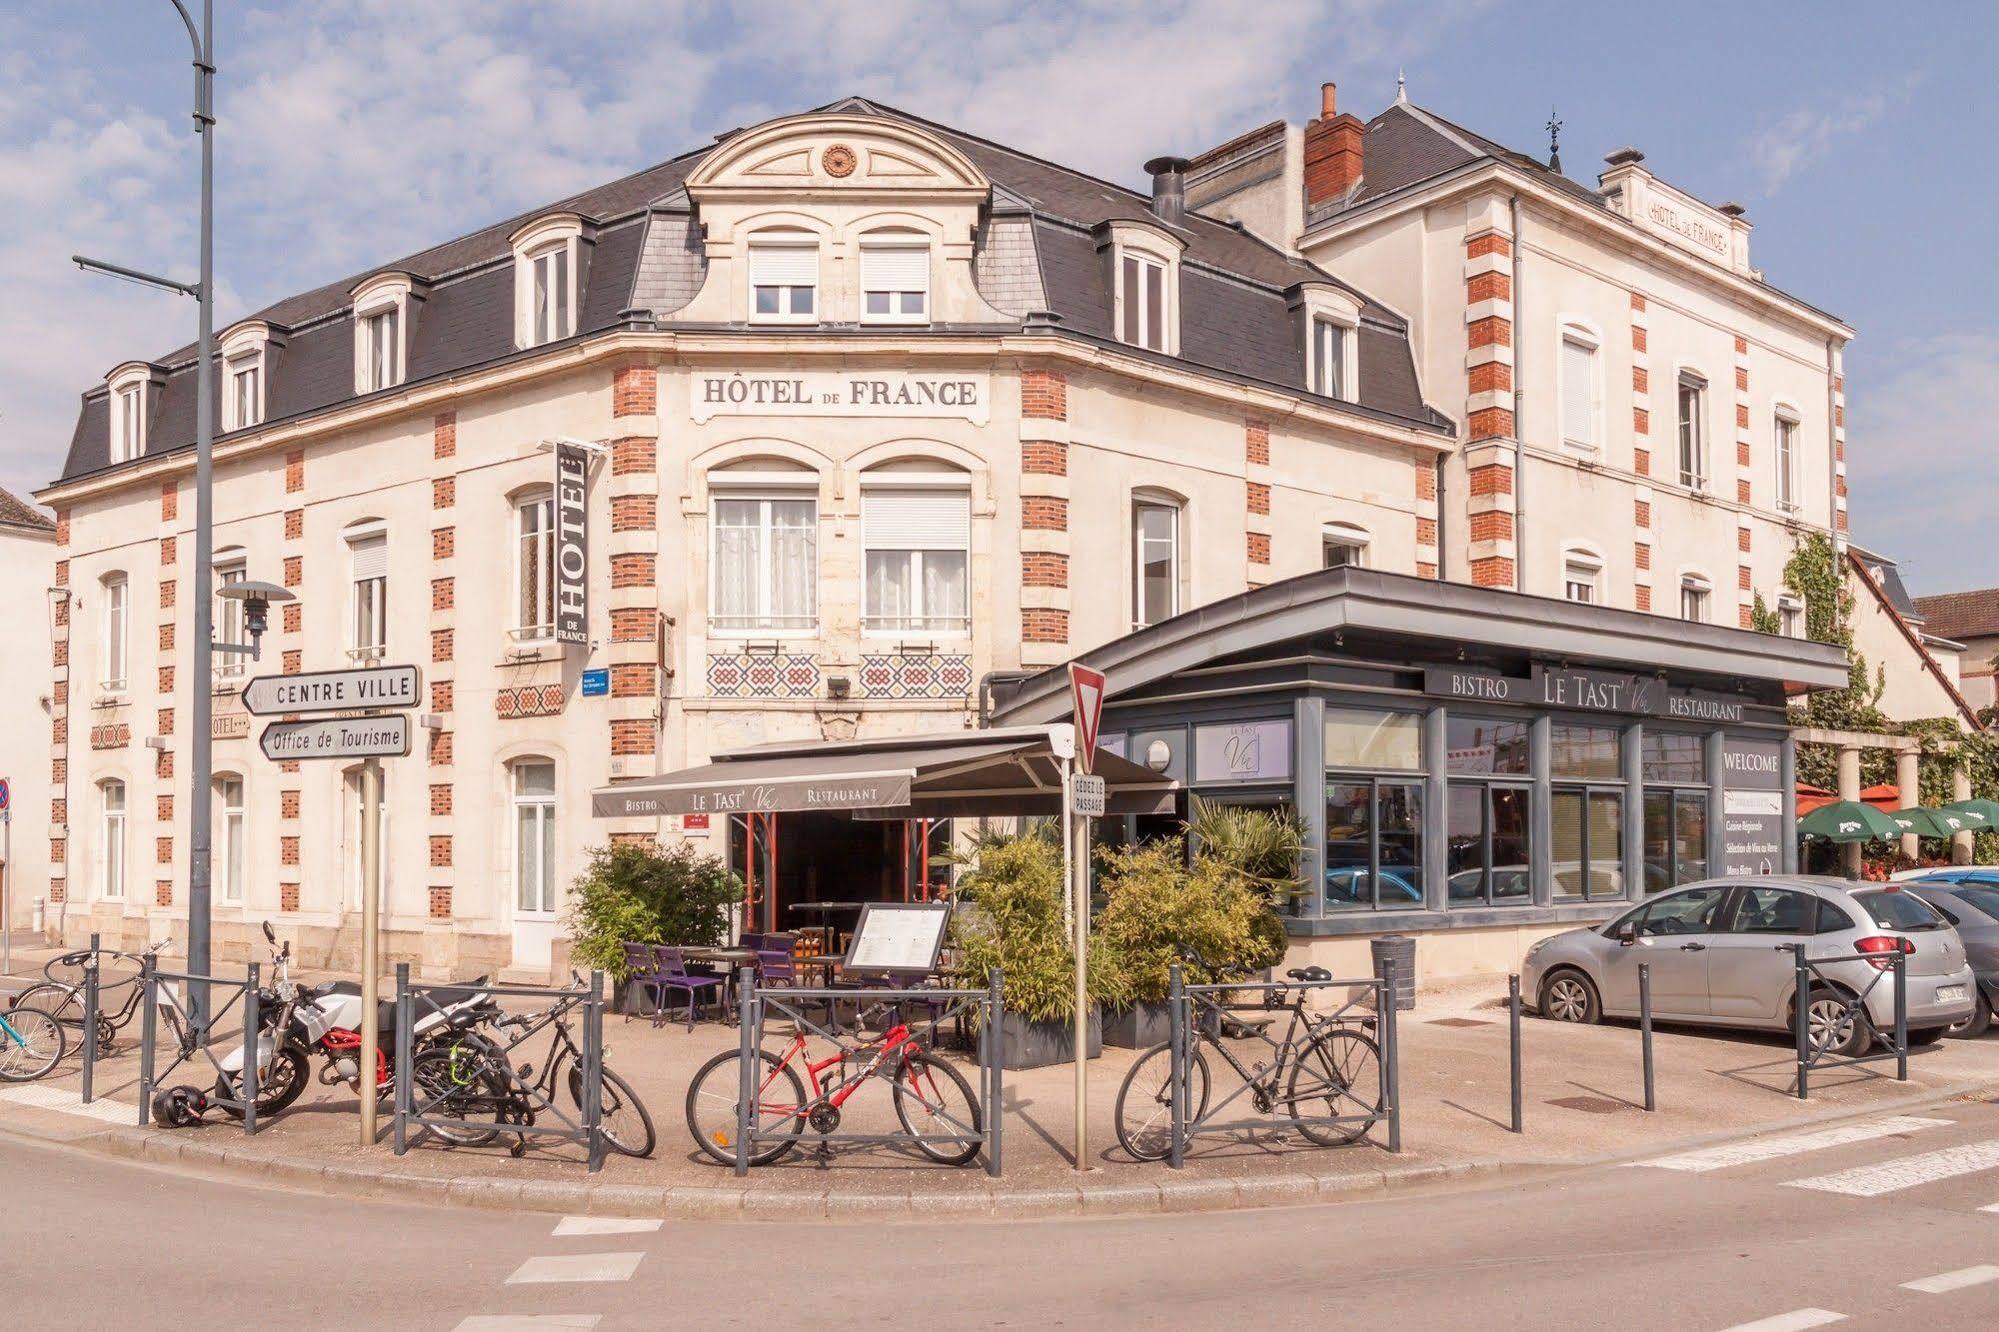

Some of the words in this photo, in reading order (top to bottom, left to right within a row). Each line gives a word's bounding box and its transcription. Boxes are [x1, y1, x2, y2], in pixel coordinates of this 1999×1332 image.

[703, 370, 812, 404] HÔTEL
[822, 393, 840, 405] DE
[849, 381, 977, 406] FRANCE
[560, 460, 585, 619] HOTEL
[558, 630, 588, 642] FRANCE
[567, 621, 578, 631] DE
[277, 682, 344, 704] CENTRE
[357, 677, 410, 699] VILLE
[1451, 674, 1508, 699] BISTRO
[1543, 672, 1566, 704] LE
[1669, 697, 1743, 721] RESTAURANT
[213, 714, 236, 735] OTEL
[273, 731, 310, 750] Office
[317, 730, 332, 749] de
[340, 726, 400, 748] Tourisme
[1723, 752, 1778, 772] WELCOME
[625, 799, 657, 811] BISTRO
[808, 788, 878, 803] RESTAURANT
[1075, 798, 1103, 811] PASSAGE
